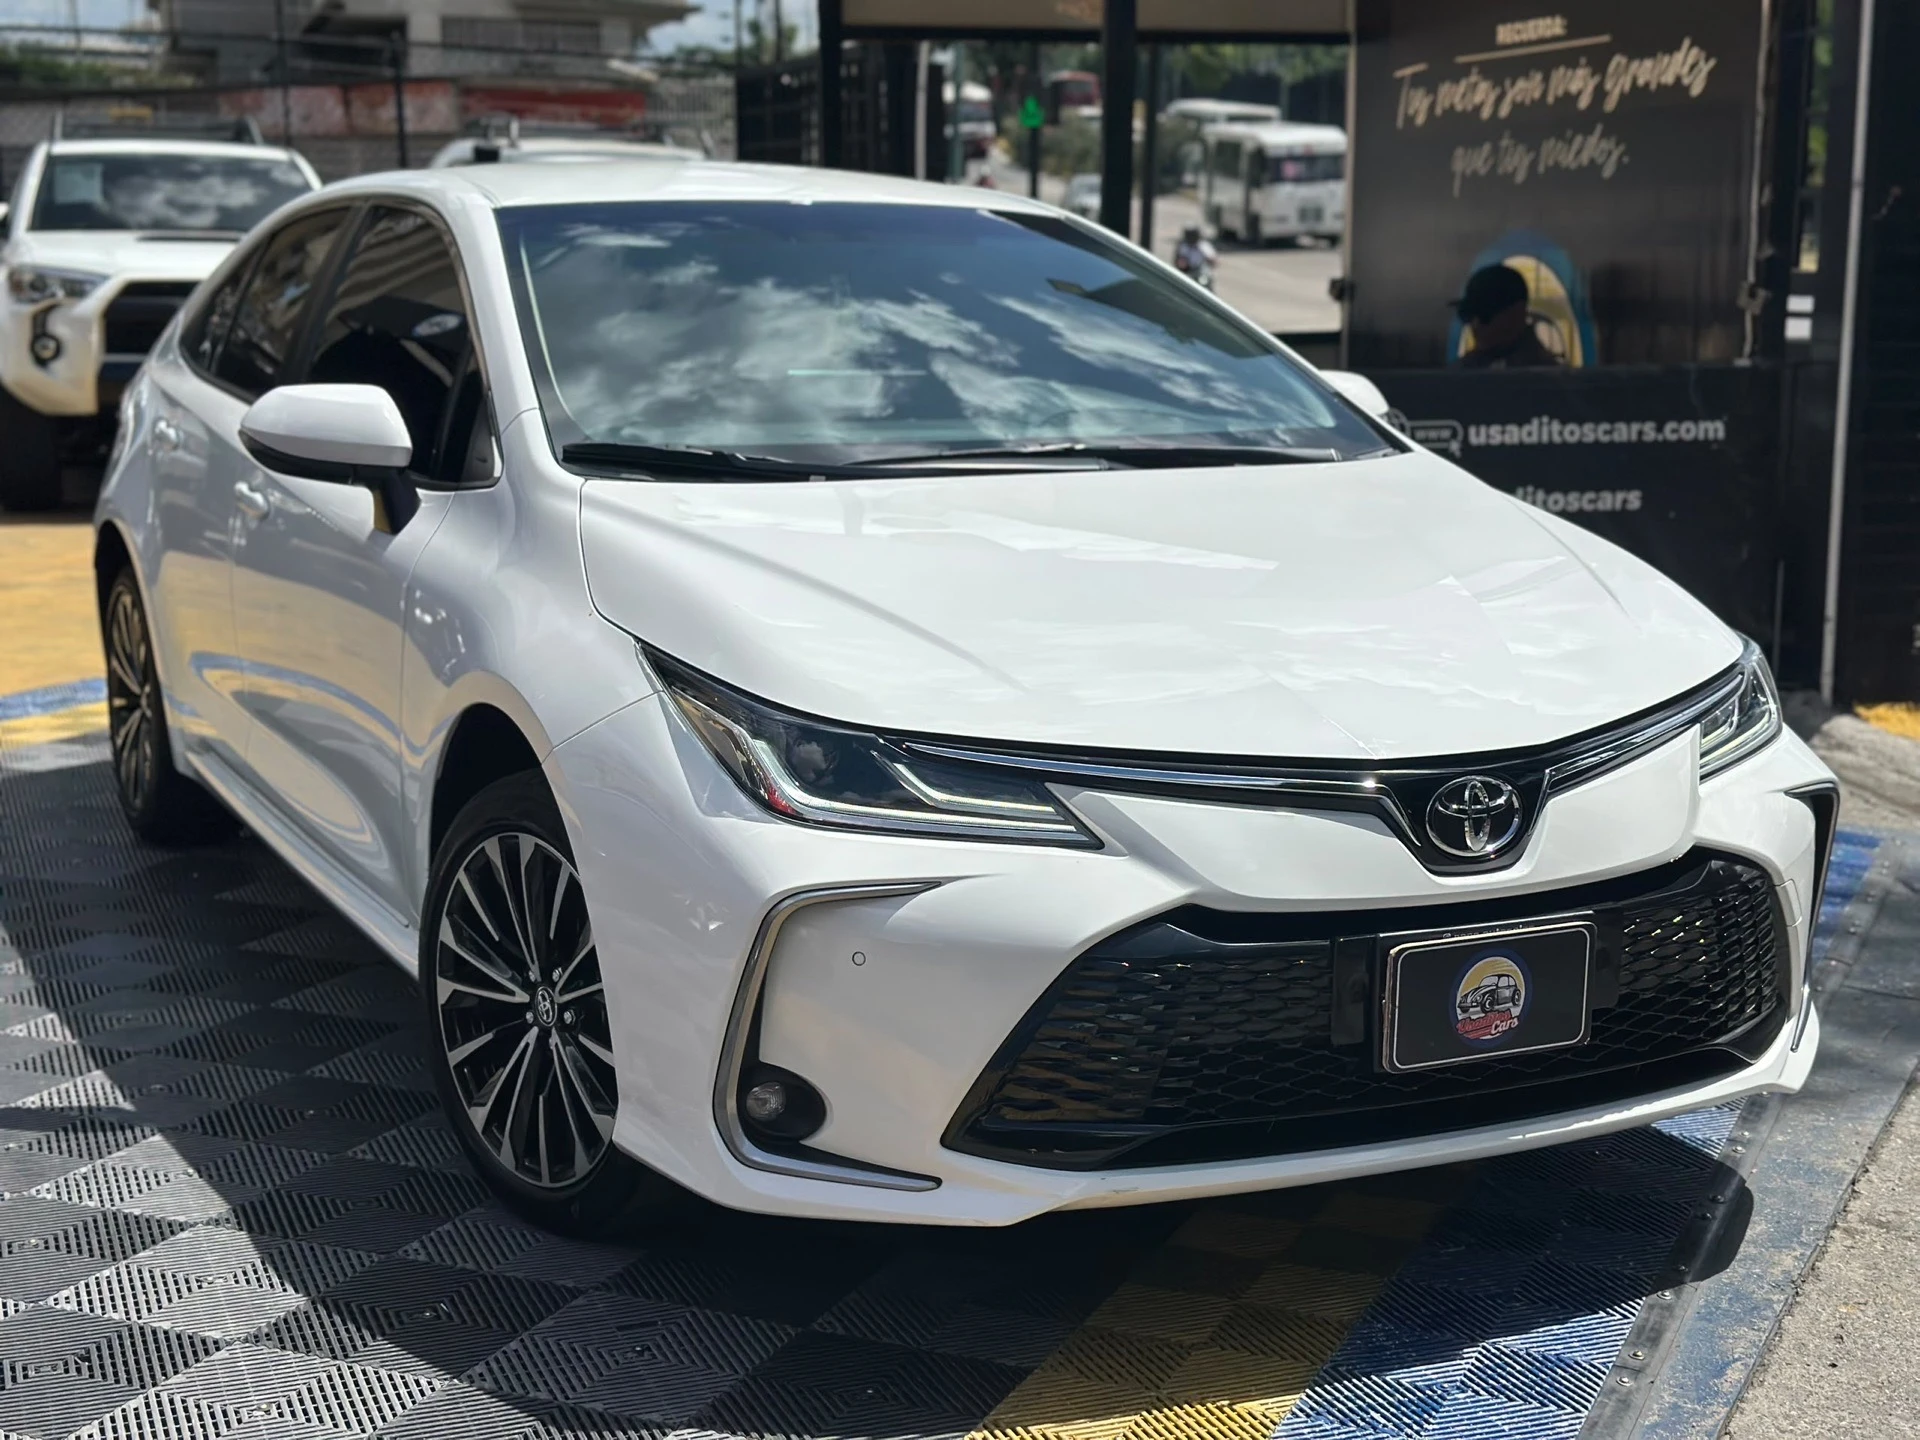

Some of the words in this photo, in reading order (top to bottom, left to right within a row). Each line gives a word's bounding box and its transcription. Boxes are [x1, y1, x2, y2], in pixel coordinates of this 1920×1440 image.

[1434, 65, 1502, 121] metas
[1497, 69, 1546, 119] son
[1452, 141, 1496, 198] que
[1497, 129, 1536, 185] tus
[1468, 415, 1725, 446] usaditoscars.com
[1491, 1017, 1519, 1035] Cars
